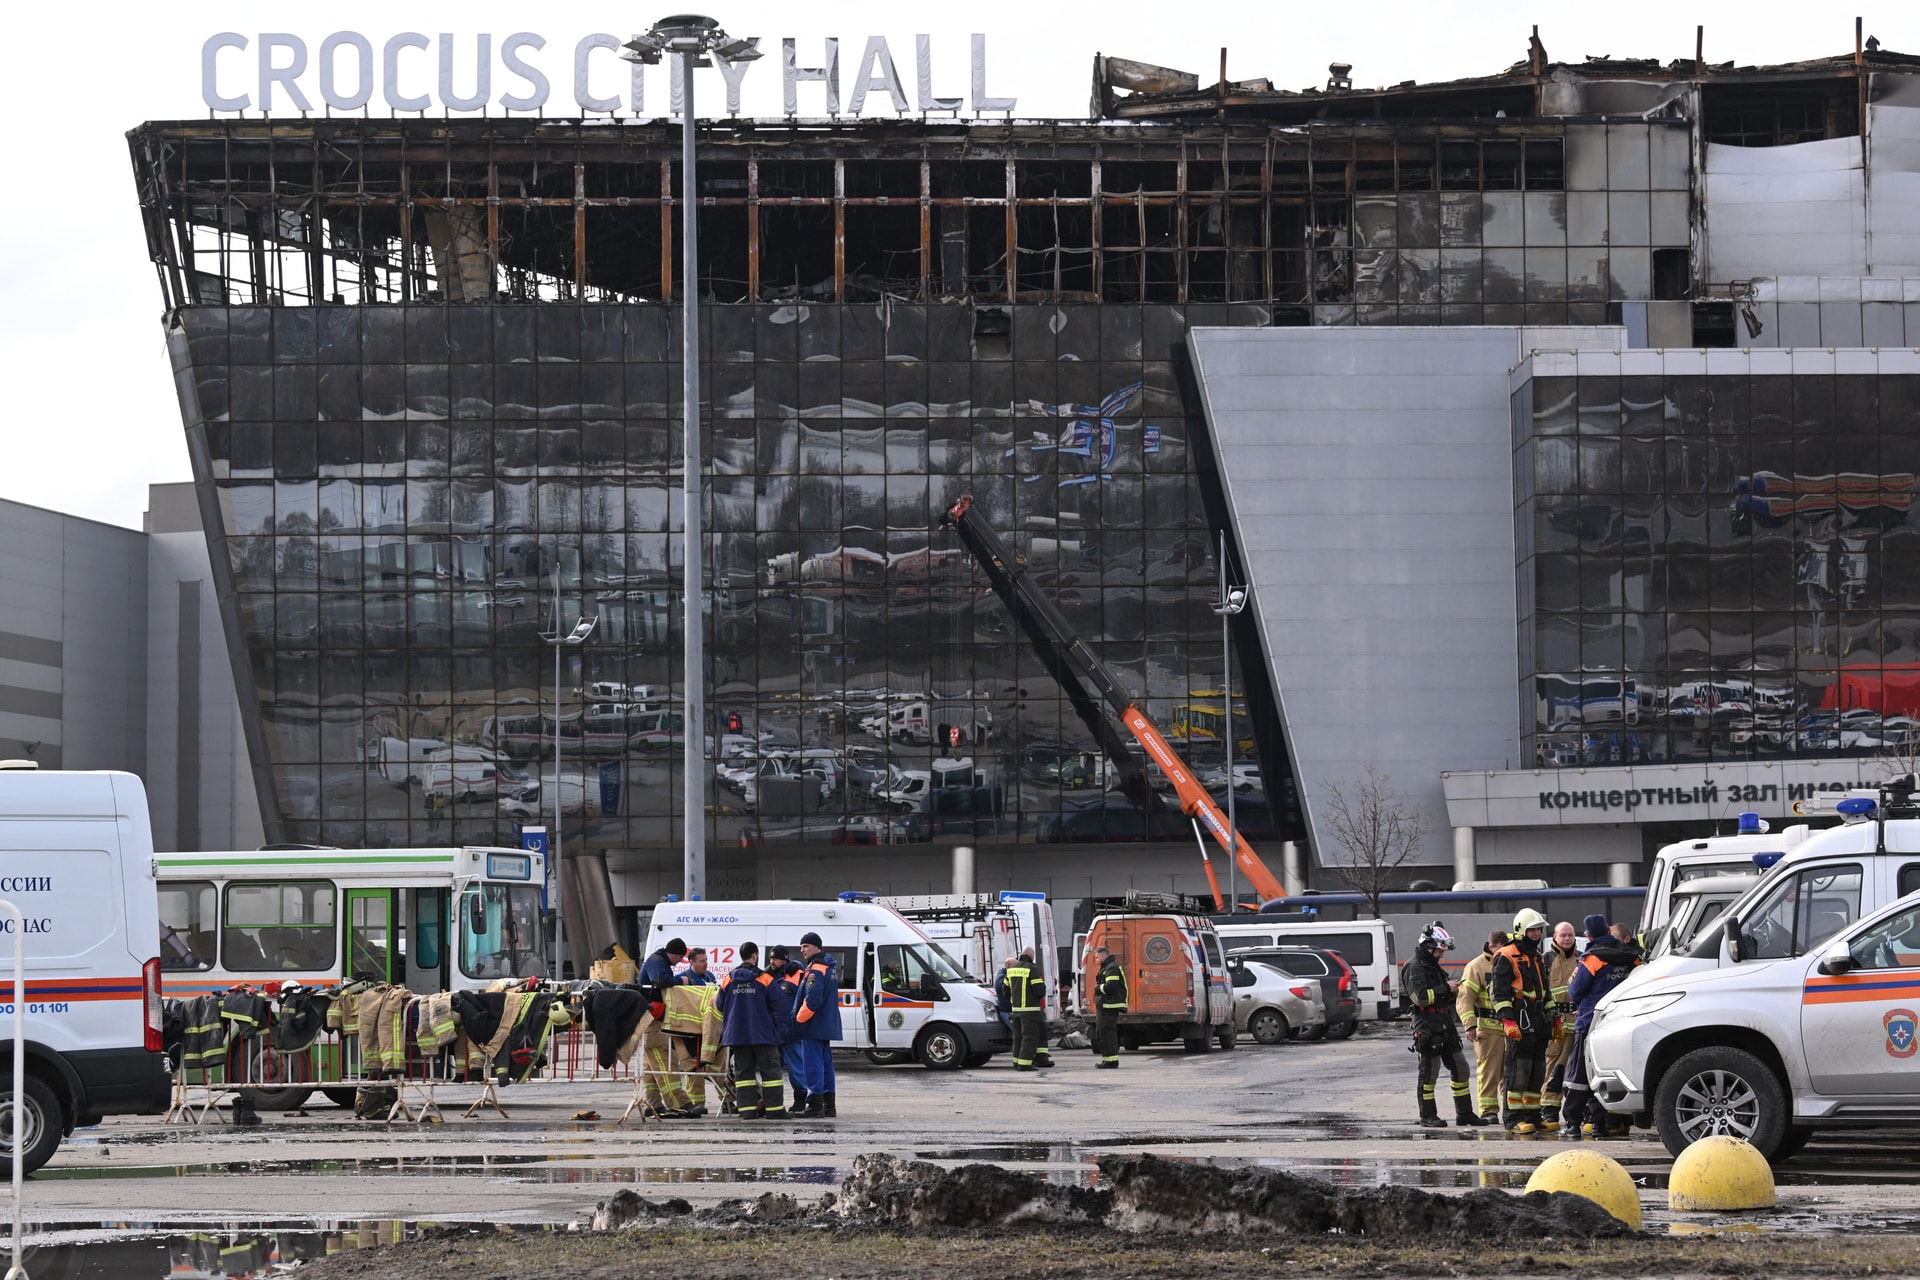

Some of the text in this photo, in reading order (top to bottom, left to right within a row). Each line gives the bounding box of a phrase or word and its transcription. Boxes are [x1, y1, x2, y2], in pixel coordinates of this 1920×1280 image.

[202, 31, 1018, 114] CROCUS CITY HALL
[1539, 779, 1718, 812] концертный
[1727, 784, 1778, 803] зал
